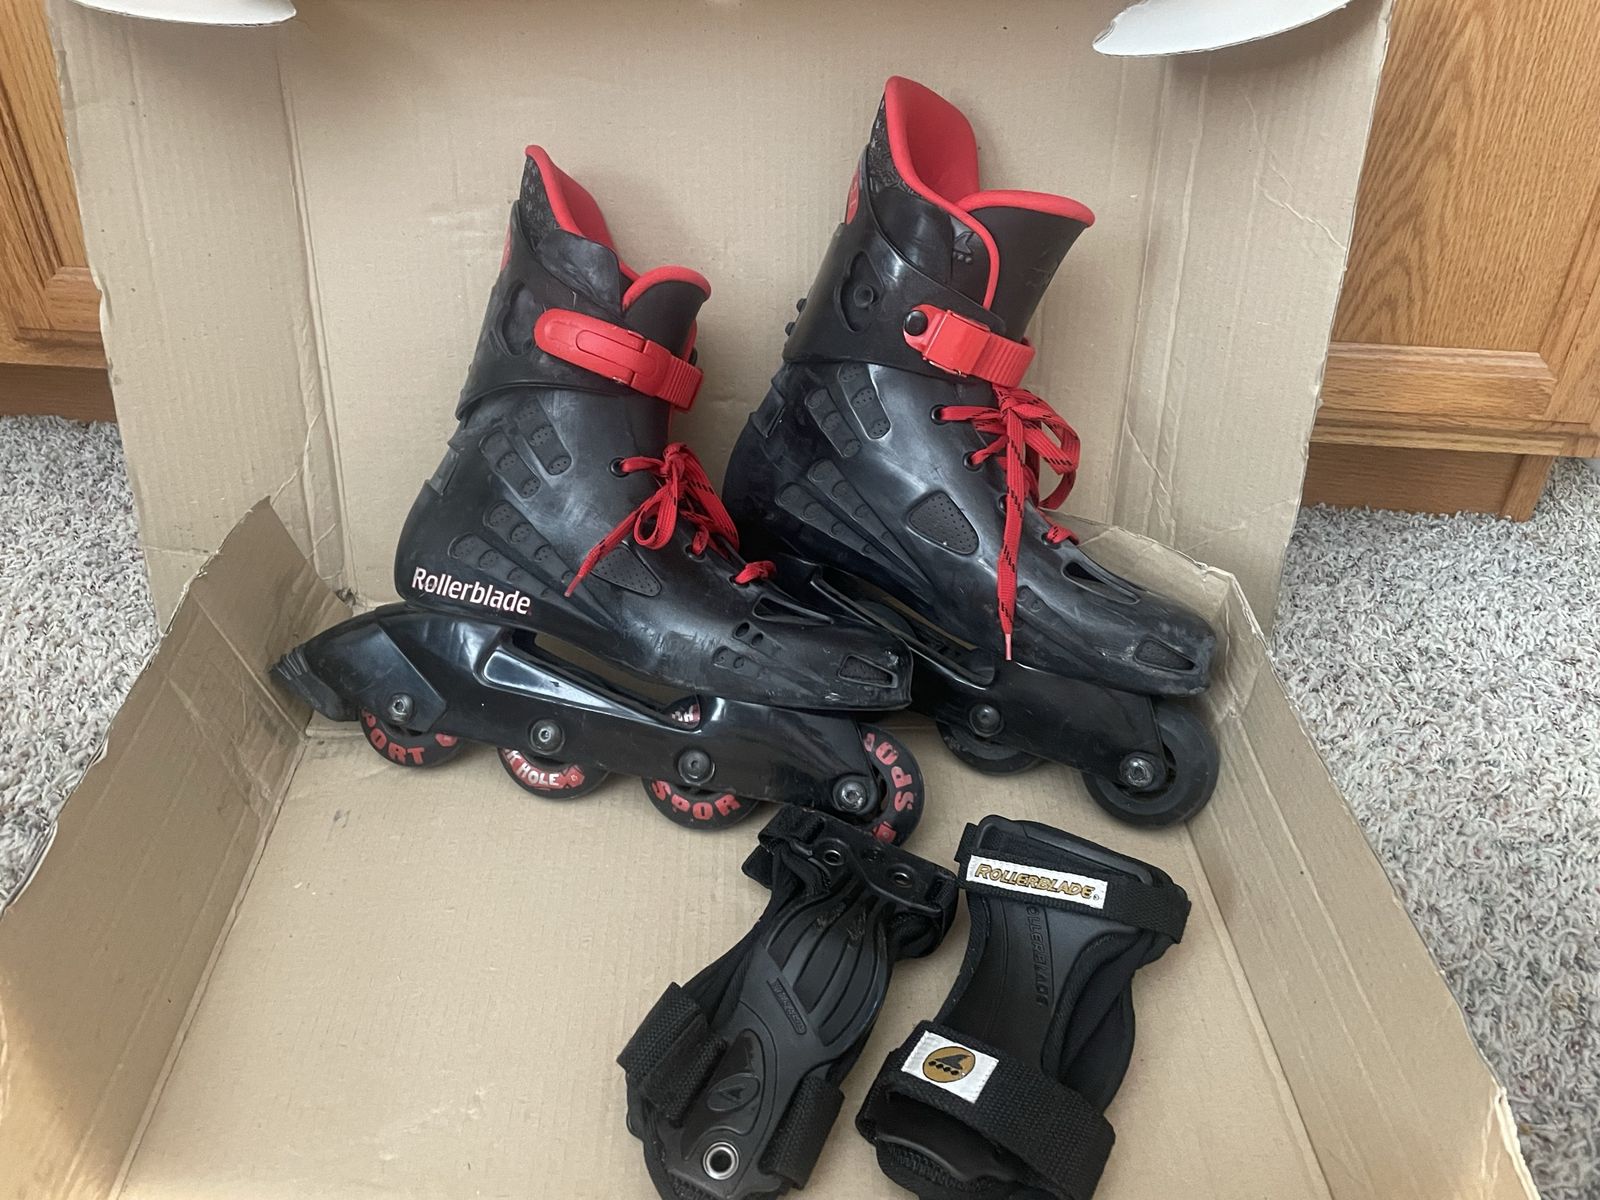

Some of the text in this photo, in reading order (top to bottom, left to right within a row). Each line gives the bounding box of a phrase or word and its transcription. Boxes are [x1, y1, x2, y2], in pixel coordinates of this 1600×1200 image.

[411, 566, 531, 615] Rollerblade
[361, 708, 425, 765] PORT
[514, 761, 560, 787] HOLE
[651, 779, 741, 821] SPOR
[975, 863, 1096, 899] ROLLERBLADE
